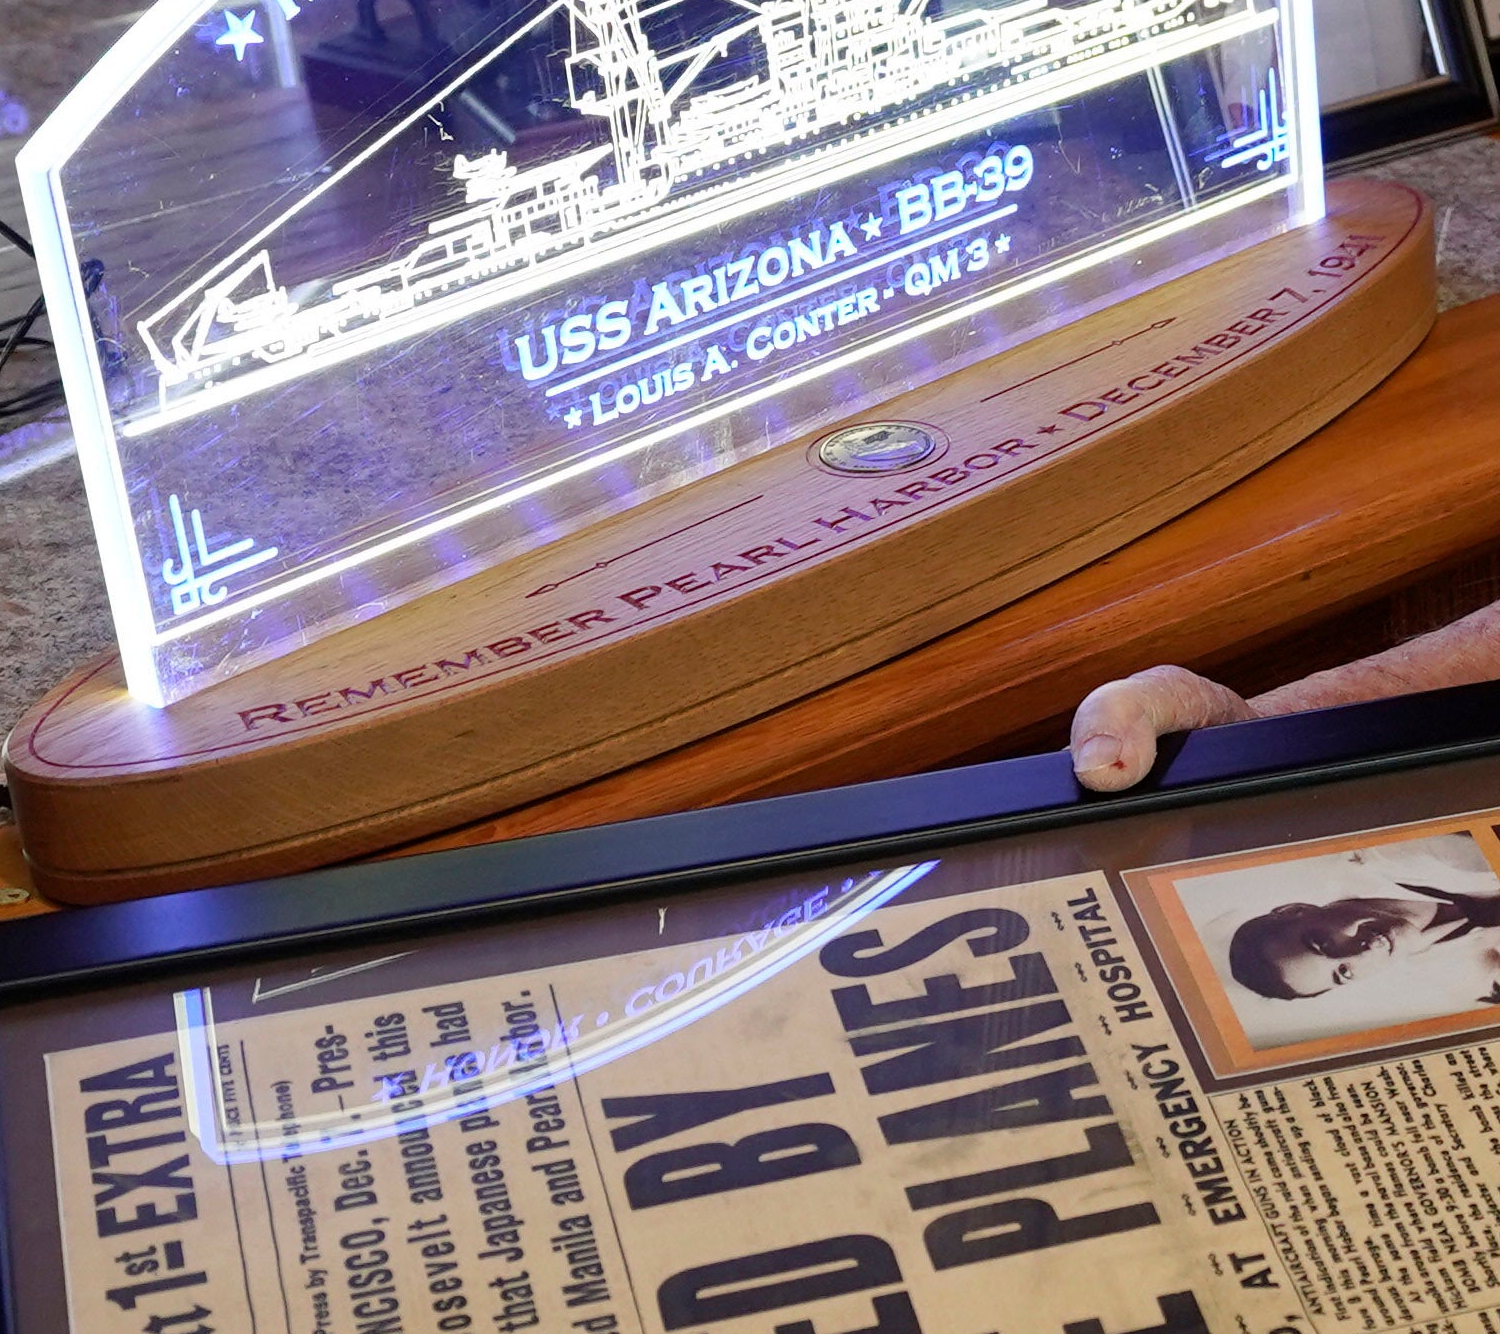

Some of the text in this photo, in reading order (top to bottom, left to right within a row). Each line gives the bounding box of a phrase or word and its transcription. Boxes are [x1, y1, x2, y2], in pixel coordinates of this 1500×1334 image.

[514, 144, 1035, 383] USS ARIZONA BB-39
[589, 237, 992, 428] LOUIS A. CONTER QM 3
[236, 606, 619, 732] REMEMBER
[616, 537, 823, 612] PEARL
[812, 434, 1040, 534] HARBOR
[1058, 305, 1288, 424] DECEMBER
[1266, 285, 1327, 308] 7,
[1306, 231, 1387, 280] 1941
[1066, 887, 1154, 1024] HOSPITAL
[216, 1044, 237, 1104] FIVE CENTS
[364, 1012, 412, 1062] this
[421, 1001, 472, 1048] had
[818, 907, 1162, 1263] PLANES
[1130, 1043, 1247, 1226] EMERGENCY
[79, 1052, 199, 1239] EXTRA
[333, 1149, 378, 1212] Dec.
[531, 1158, 585, 1206] and
[600, 1071, 862, 1211] BY
[1360, 1080, 1482, 1294] BOMB NEAR GOVERNOR'S MANSION
[285, 1165, 321, 1265] Transpacific
[465, 1140, 525, 1263] Japanese
[1223, 1118, 1326, 1315] ANTIAIRCRAFT GUNS IN ACTION
[105, 1239, 208, 1311] 1st
[304, 1269, 328, 1290] by
[488, 1270, 540, 1334] that
[550, 1214, 611, 1308] Manila
[1227, 1252, 1280, 1289] AT
